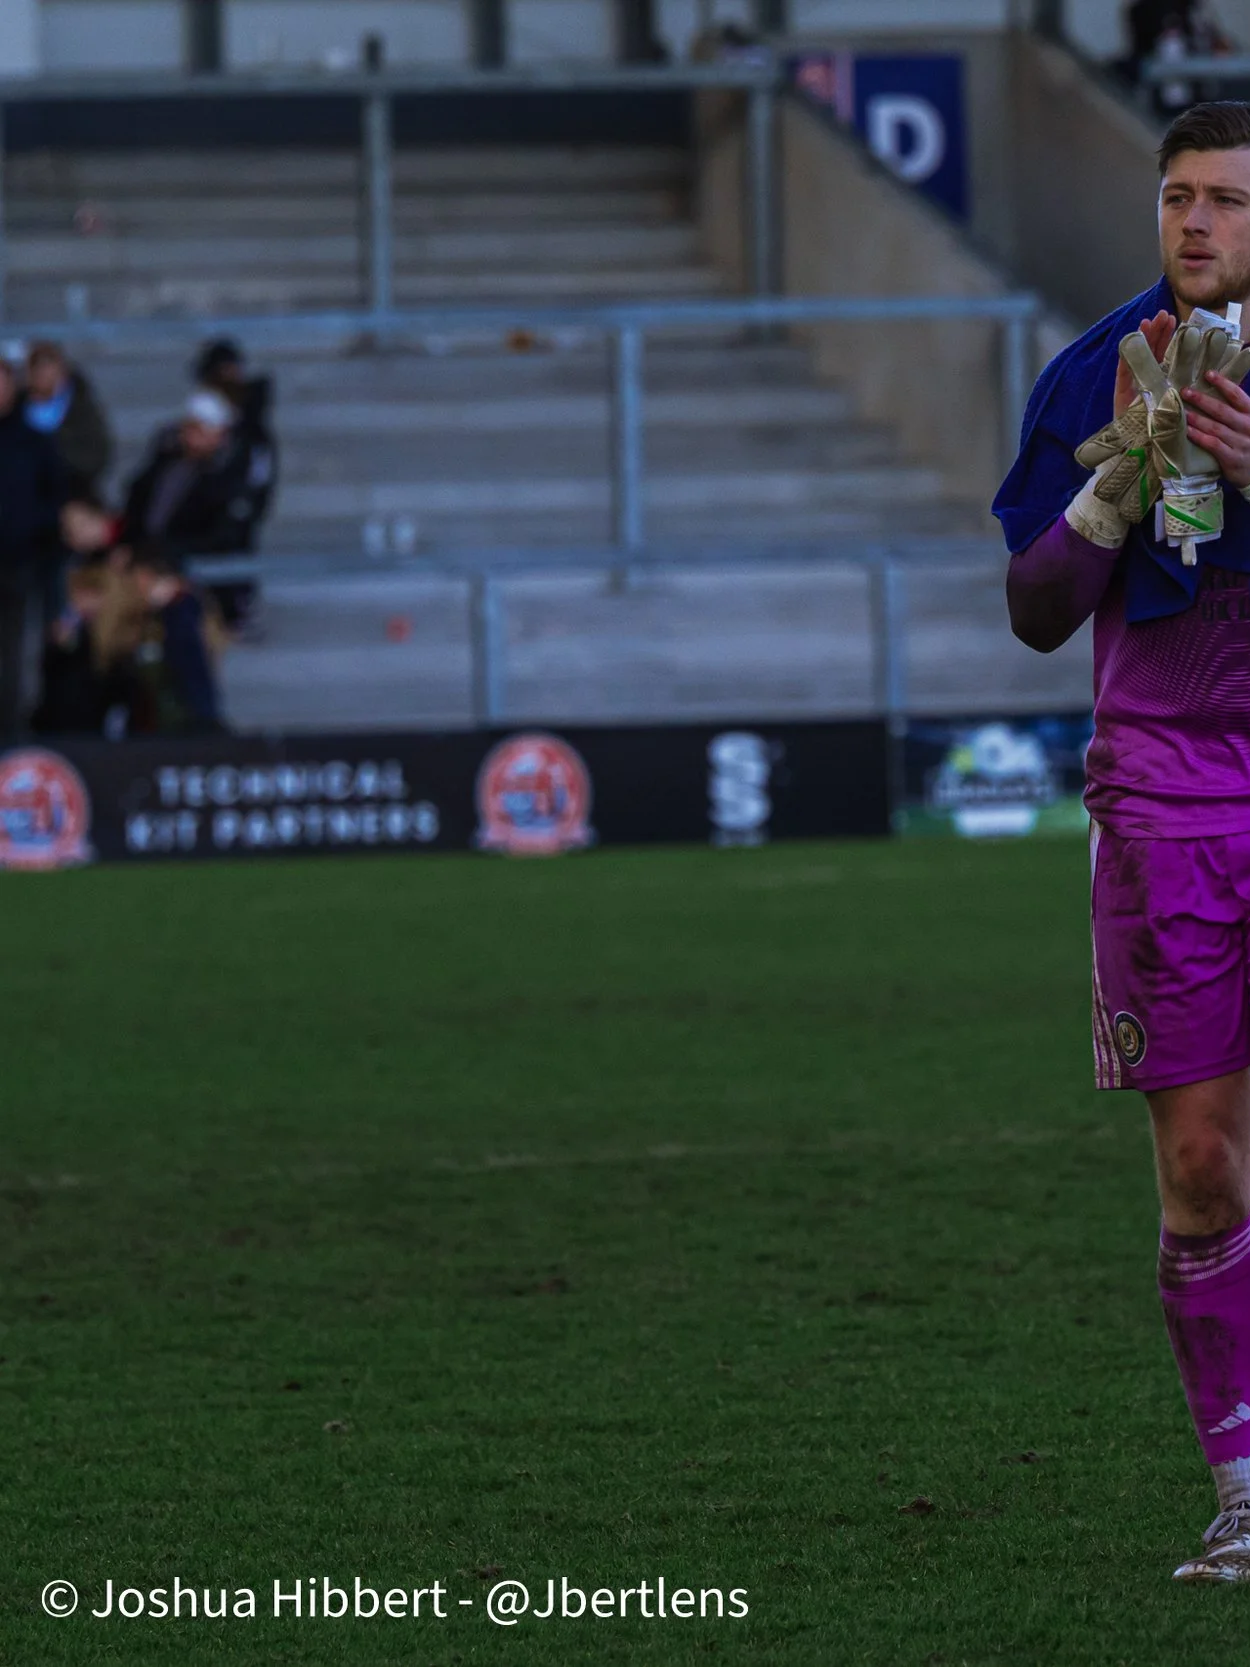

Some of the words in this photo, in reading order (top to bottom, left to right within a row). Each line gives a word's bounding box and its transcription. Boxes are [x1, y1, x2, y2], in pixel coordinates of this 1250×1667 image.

[867, 91, 946, 184] D
[157, 759, 408, 806] TECHNICAL
[126, 811, 198, 853] KIT
[211, 801, 440, 848] PARTNERS
